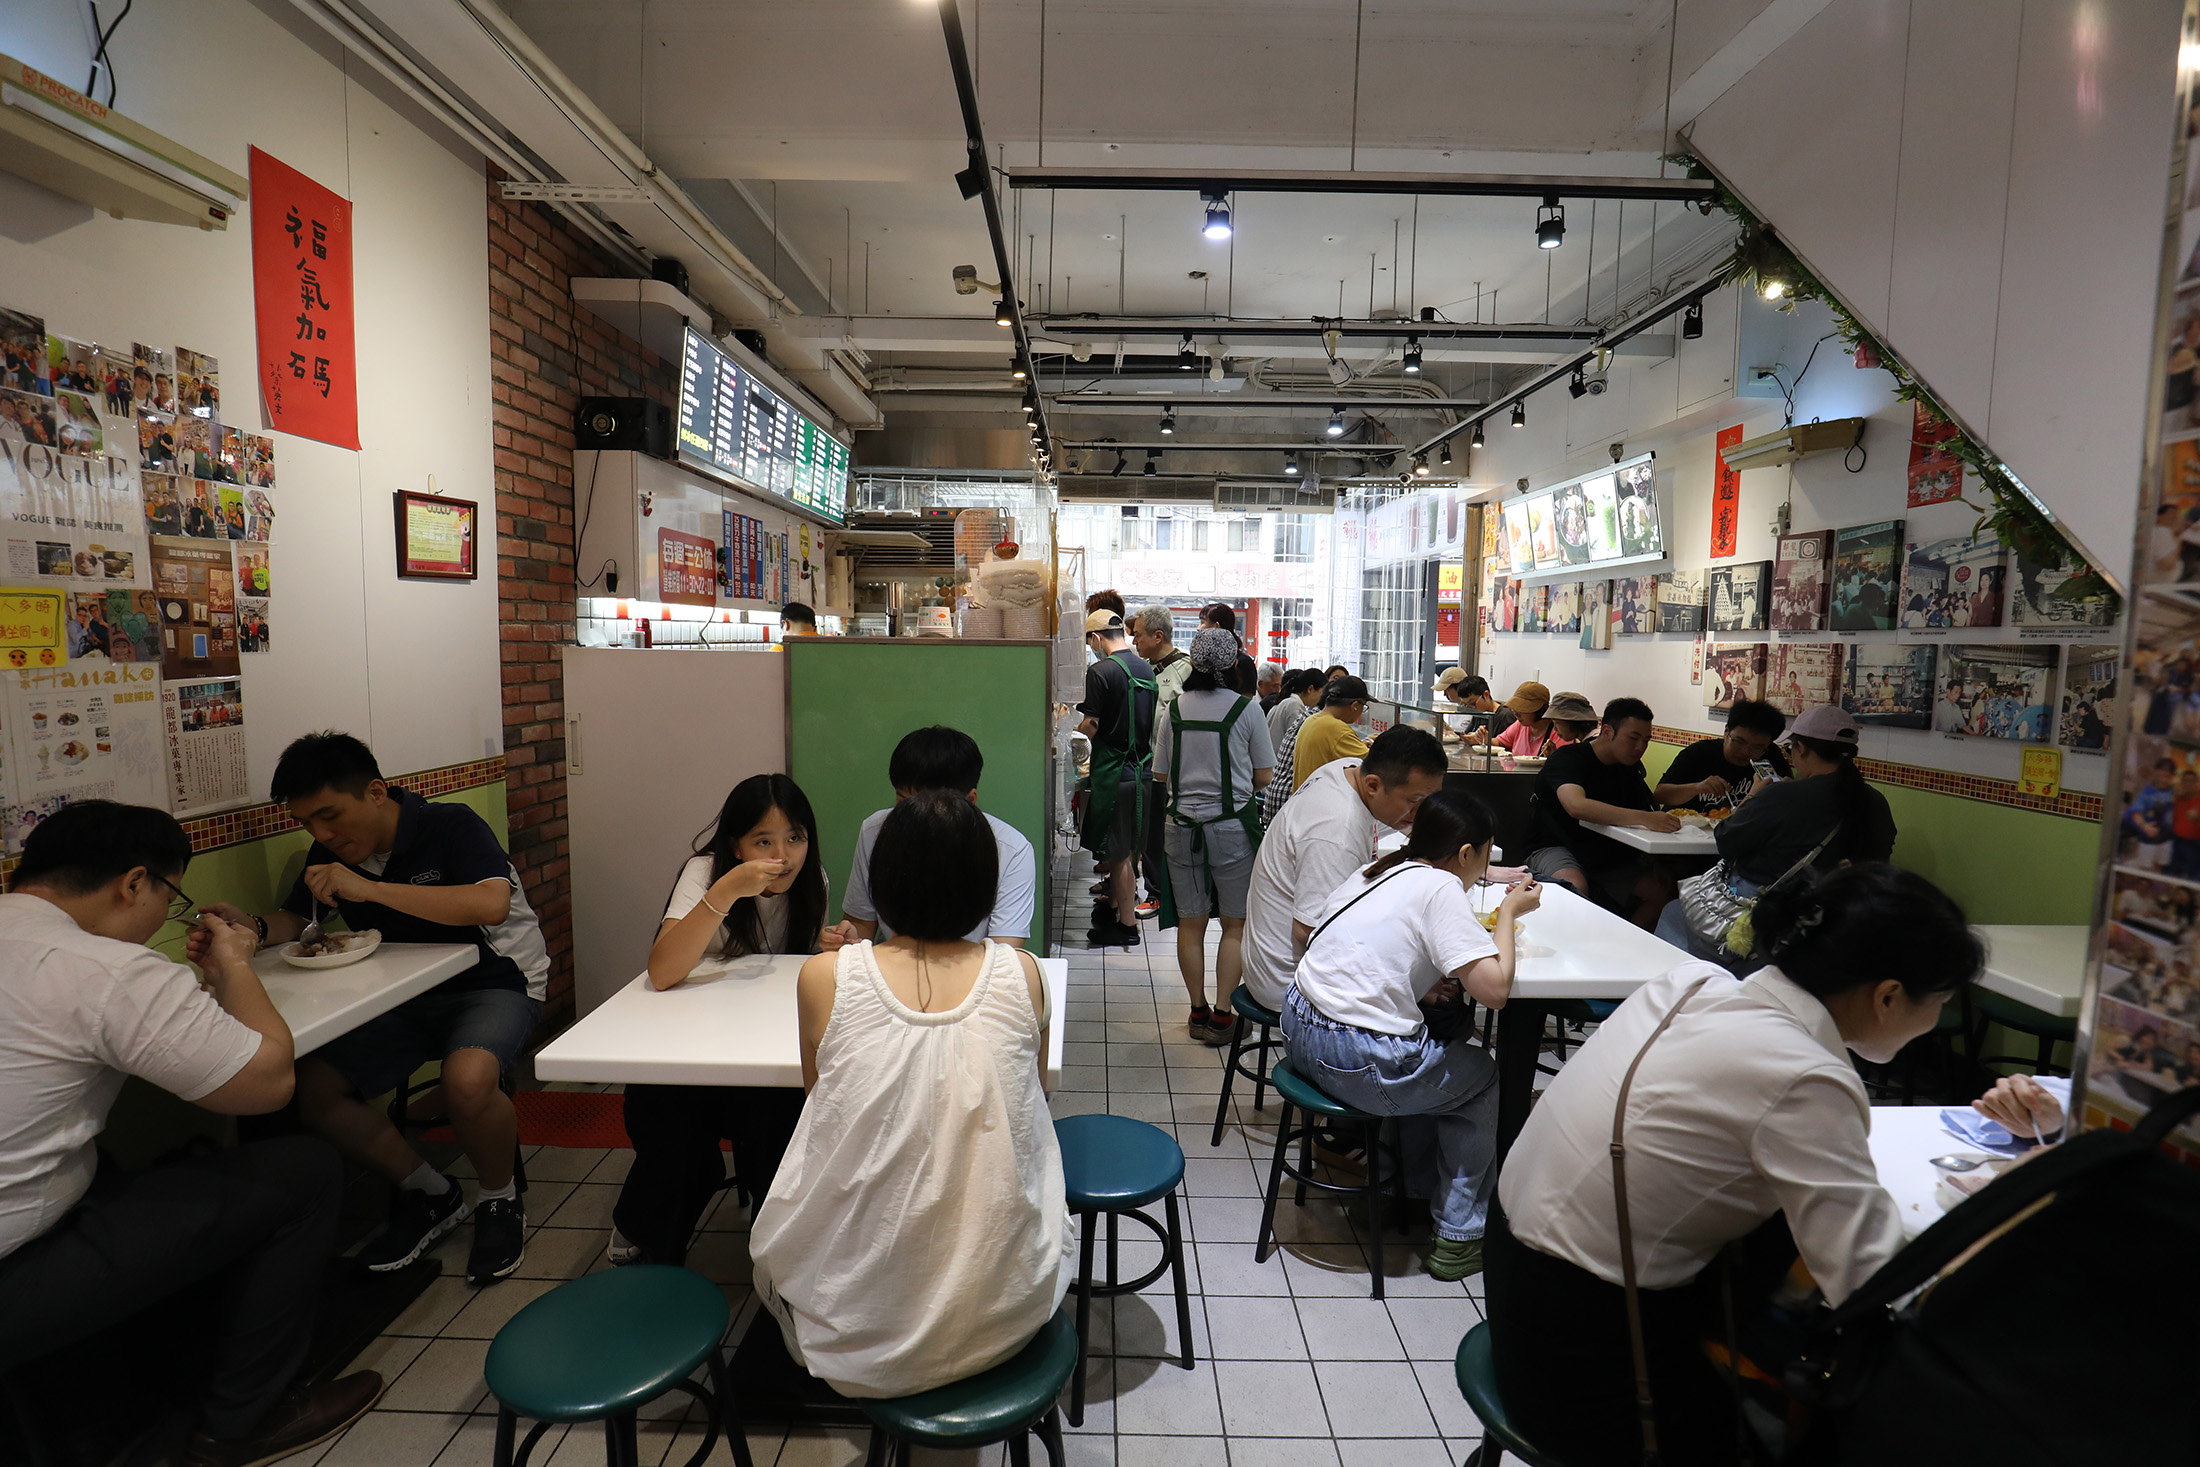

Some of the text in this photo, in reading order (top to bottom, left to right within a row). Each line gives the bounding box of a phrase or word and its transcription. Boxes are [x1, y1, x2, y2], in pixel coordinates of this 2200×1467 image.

[39, 76, 108, 118] PROCATCH
[285, 205, 329, 399] 福氣加碼
[0, 438, 130, 492] VOGUE
[12, 512, 52, 525] VOGUE
[663, 538, 713, 570] 每週三公休
